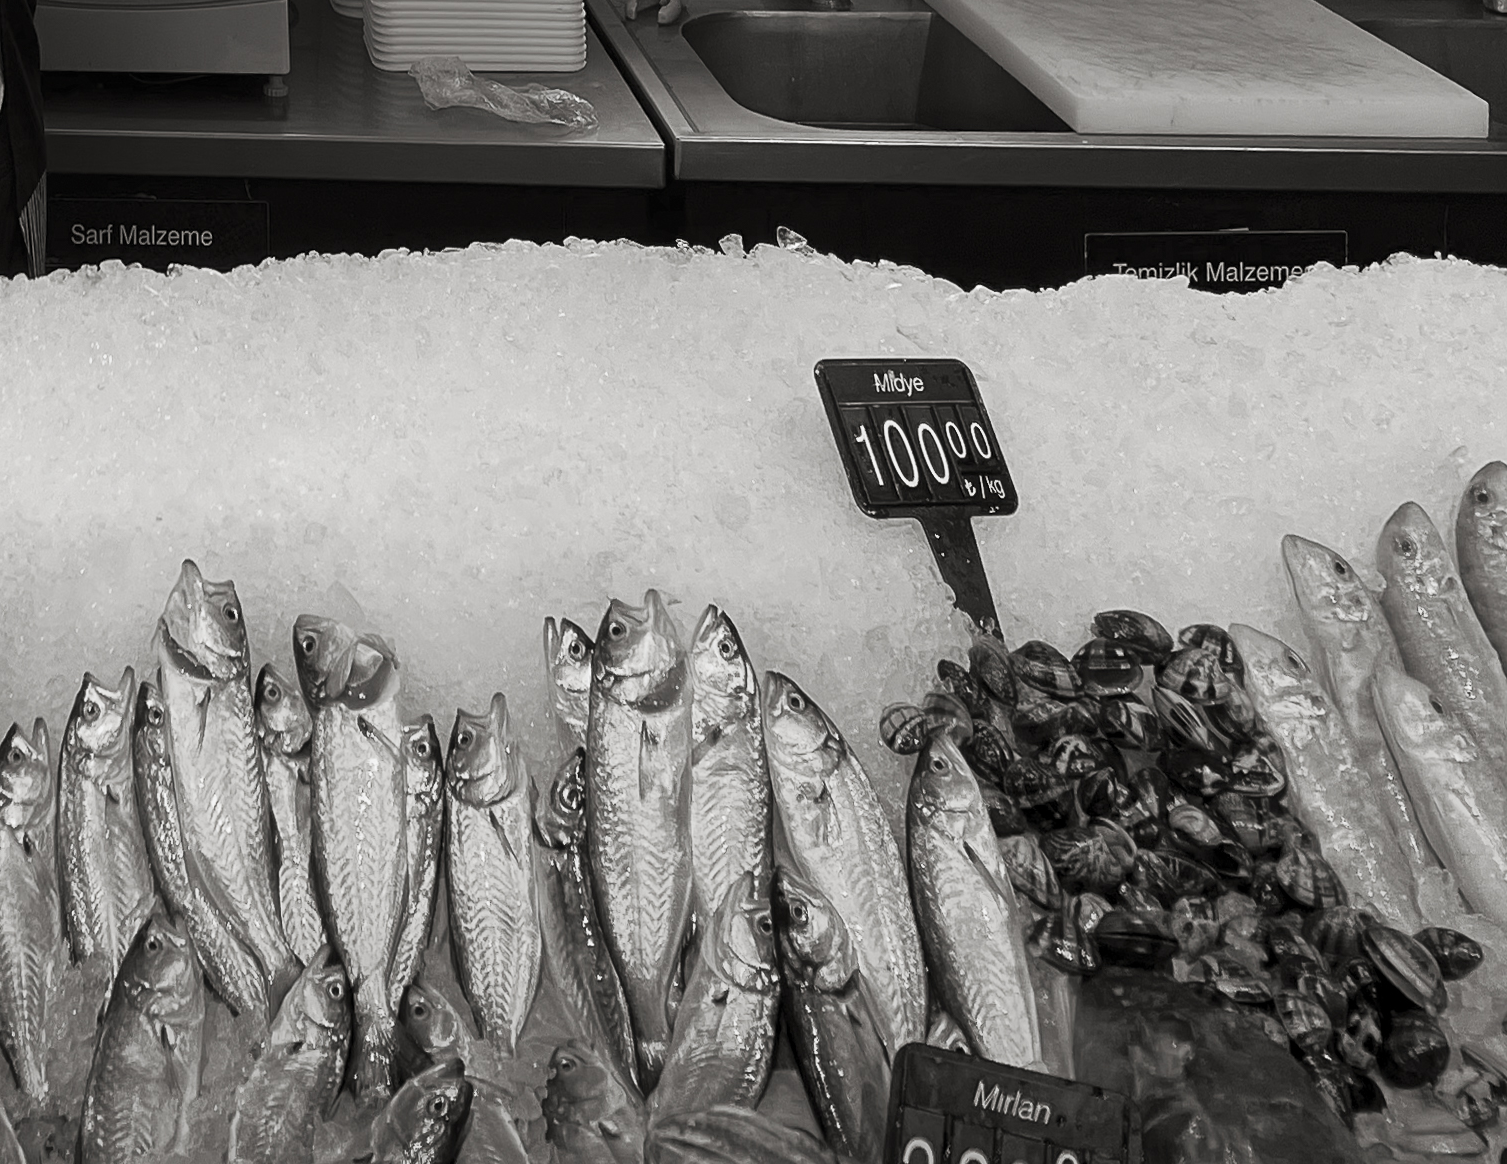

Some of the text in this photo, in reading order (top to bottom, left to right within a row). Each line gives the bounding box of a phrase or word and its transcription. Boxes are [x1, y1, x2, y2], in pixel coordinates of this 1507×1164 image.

[71, 223, 213, 246] Sarf Malzeme
[873, 369, 925, 397] Midye
